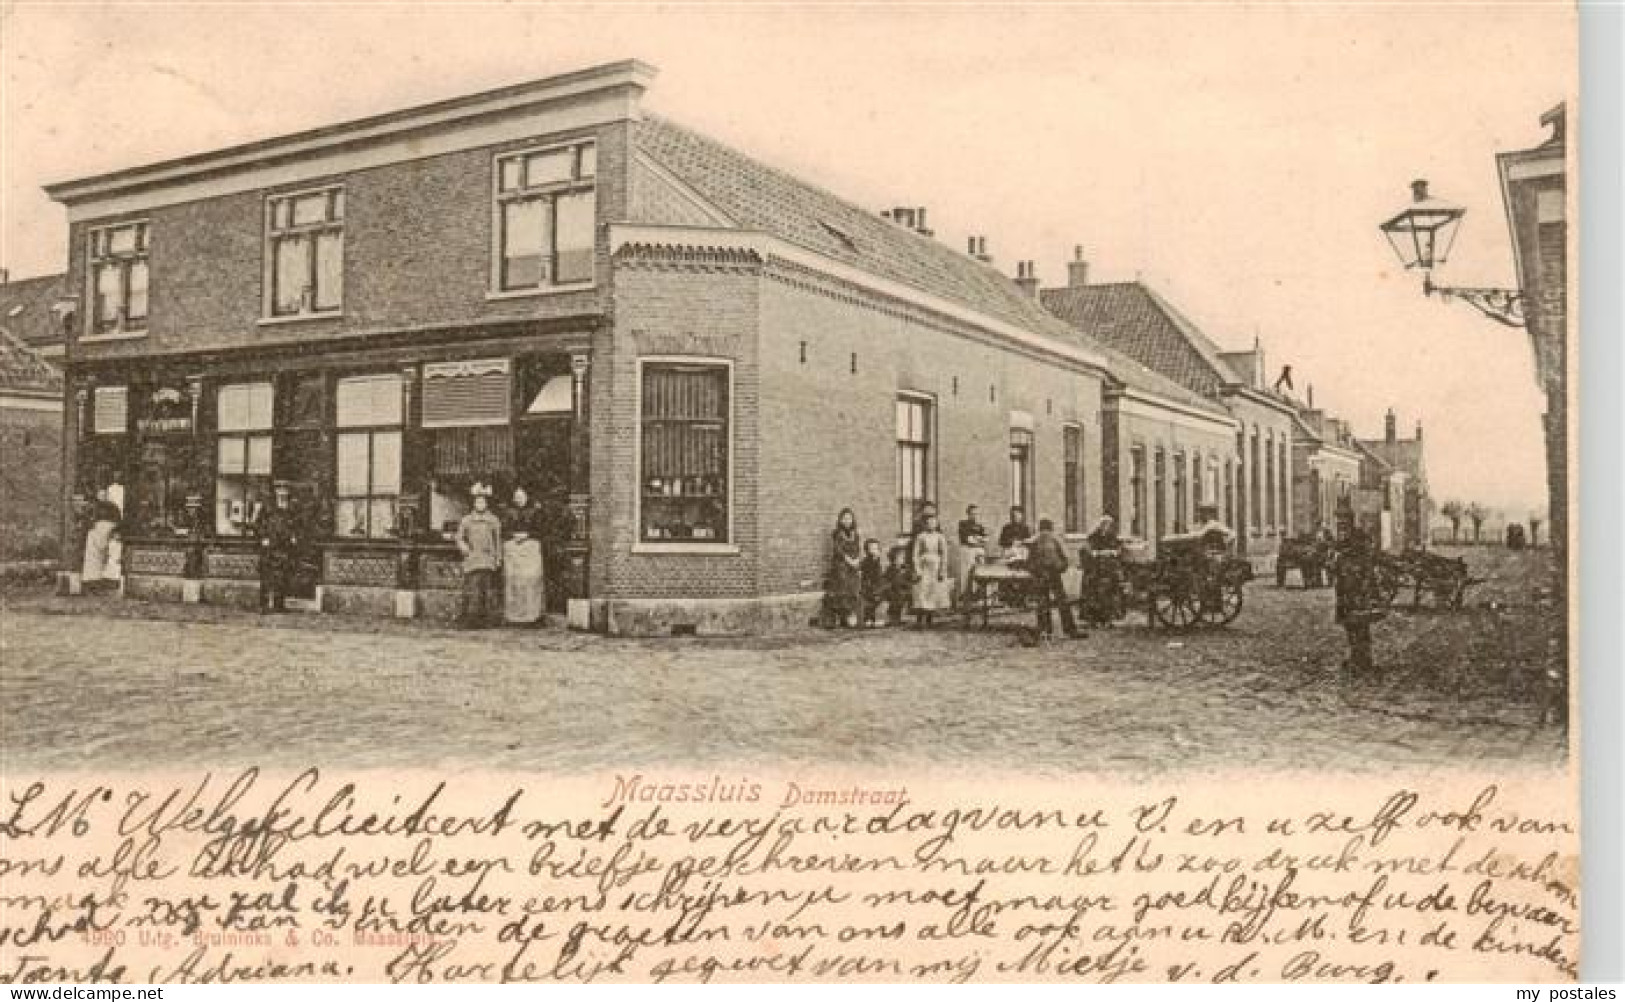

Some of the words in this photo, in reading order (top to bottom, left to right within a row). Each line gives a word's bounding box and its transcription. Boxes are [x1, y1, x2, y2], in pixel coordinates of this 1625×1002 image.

[602, 774, 763, 808] Maassluis
[522, 805, 625, 842] met
[626, 805, 677, 841] de
[1184, 815, 1246, 836] en
[1416, 784, 1499, 831] ook
[1490, 815, 1575, 834] van
[1362, 836, 1466, 875] met
[410, 874, 512, 915] later
[285, 928, 300, 948] &
[312, 928, 340, 948] Co.
[497, 914, 560, 943] de
[1420, 921, 1458, 950] de
